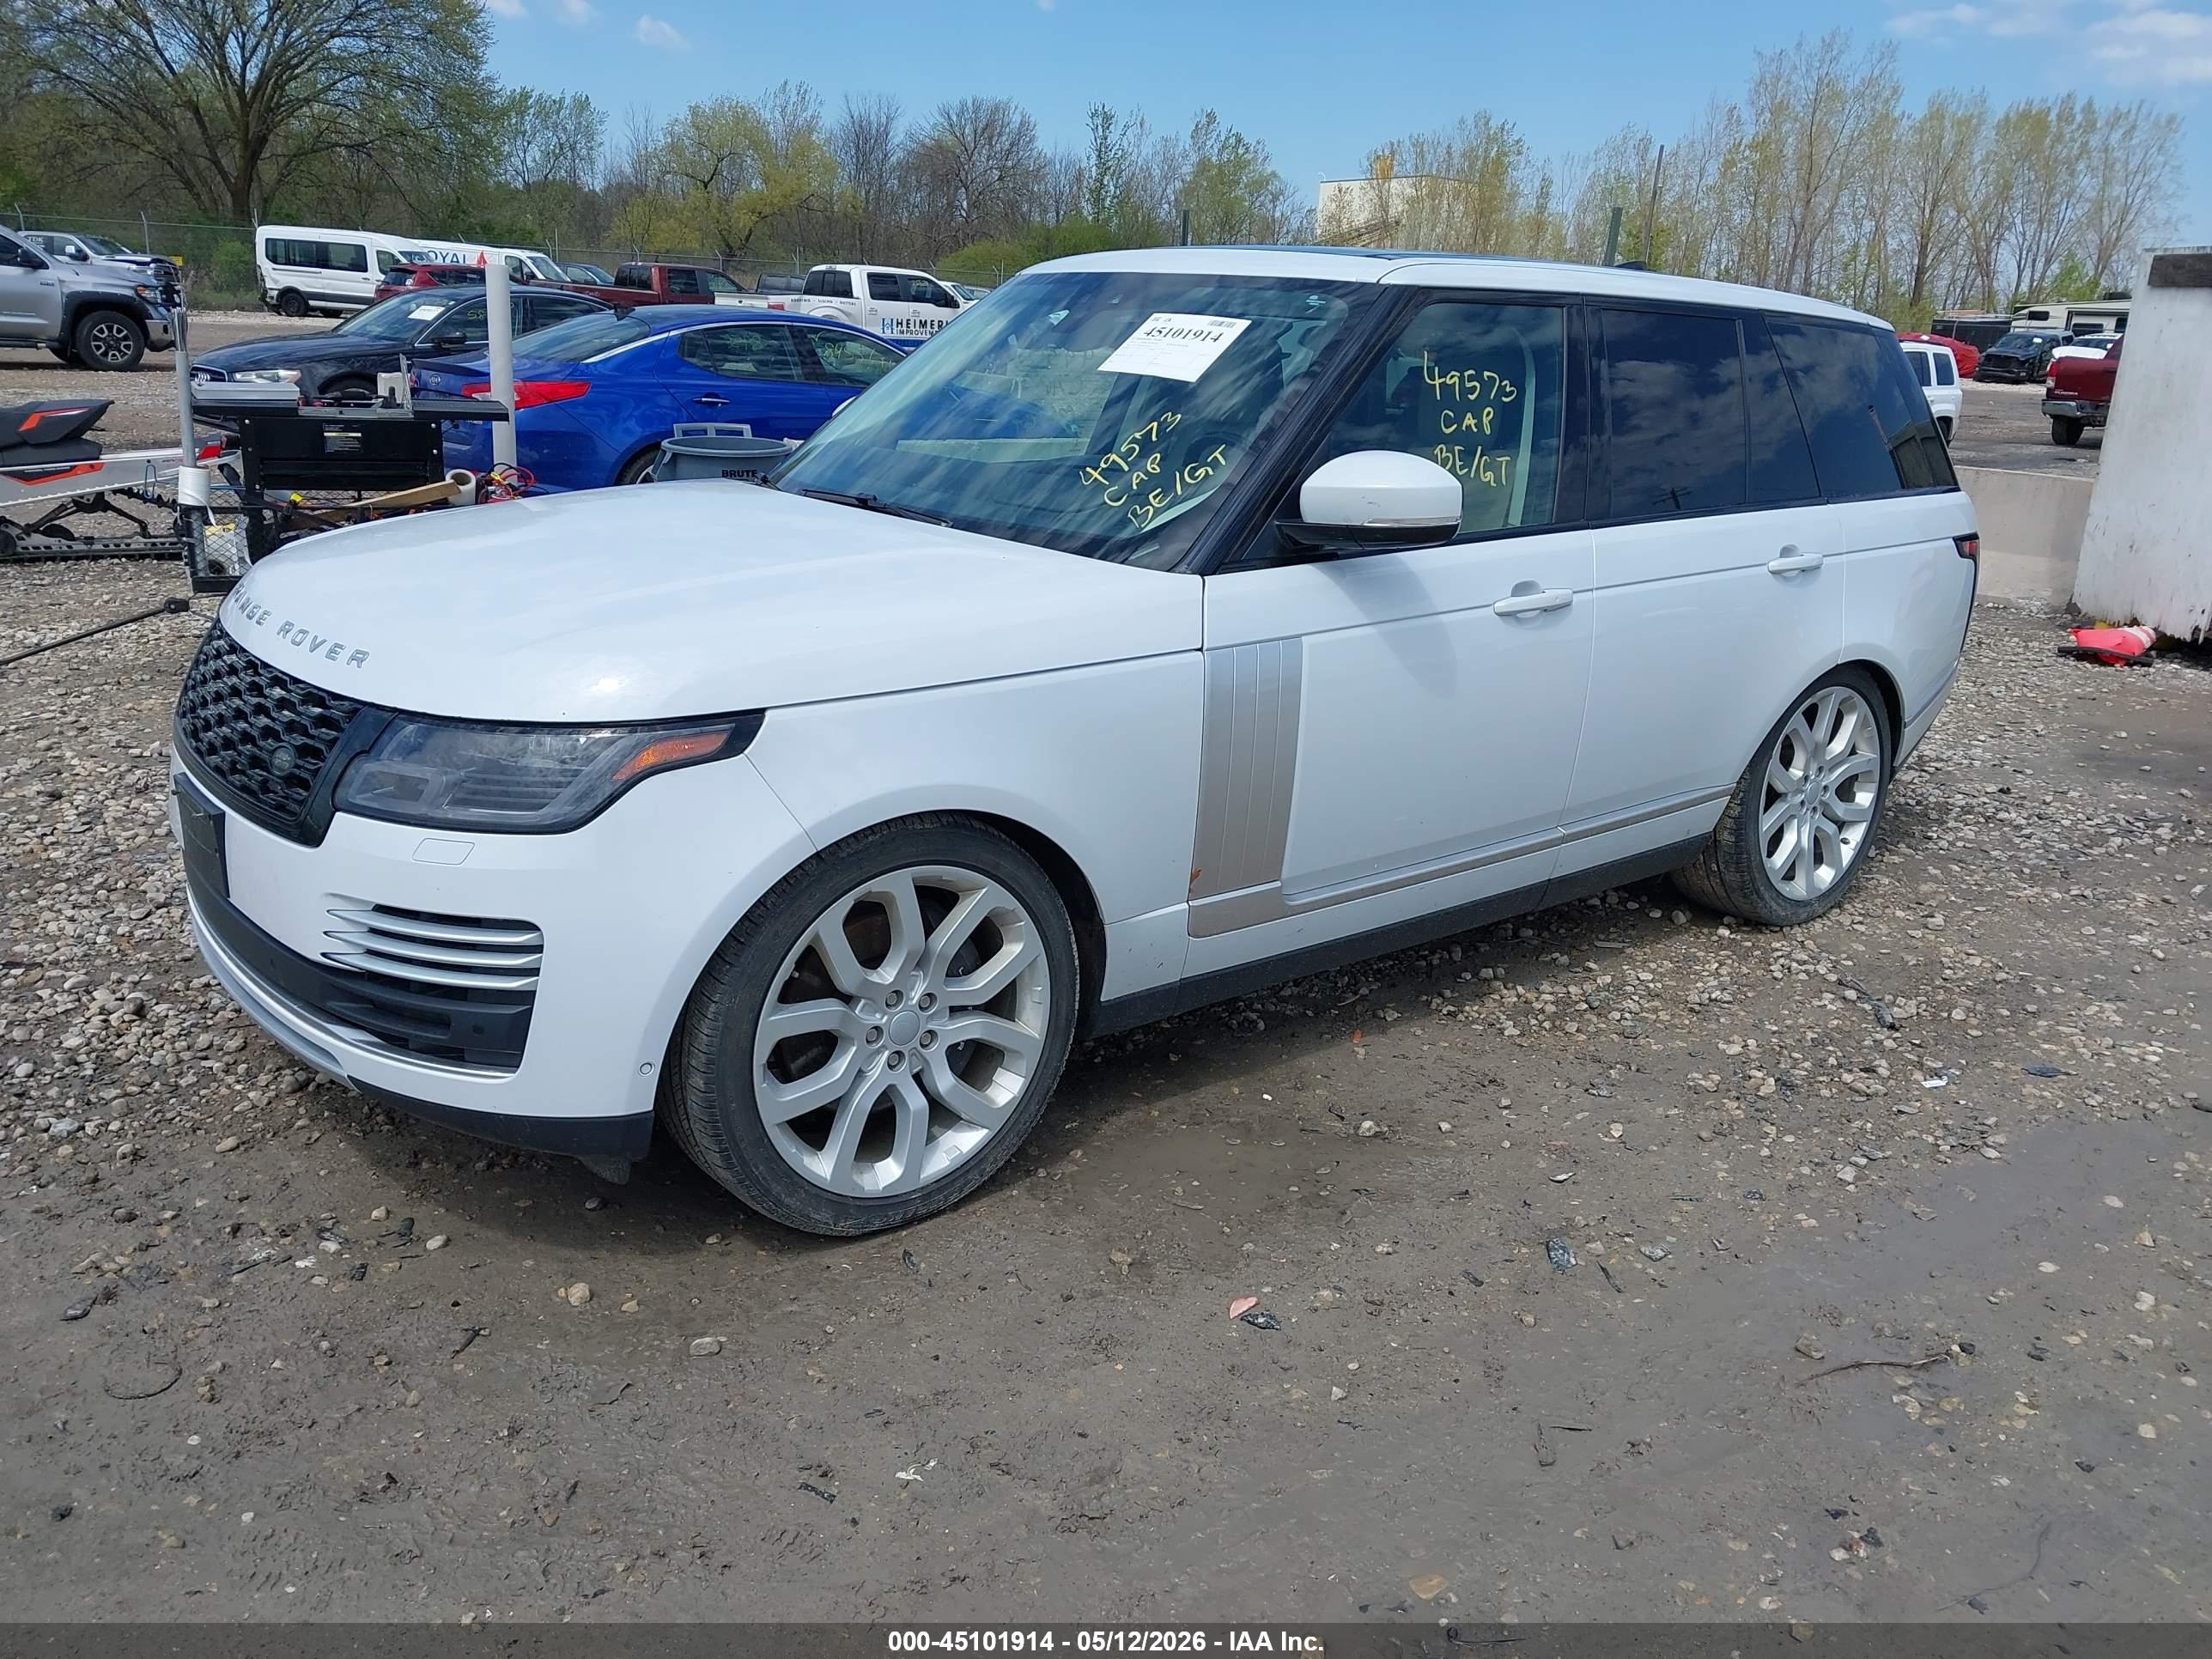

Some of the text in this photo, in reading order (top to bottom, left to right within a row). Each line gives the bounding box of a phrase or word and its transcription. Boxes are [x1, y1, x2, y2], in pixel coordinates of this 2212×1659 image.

[1143, 325, 1224, 343] 45101914
[1423, 349, 1517, 403] 49573
[1079, 411, 1182, 486] 49573
[1433, 443, 1511, 488] BE/GT
[721, 469, 757, 478] BRUTE
[233, 583, 371, 669] RANGE ROVER
